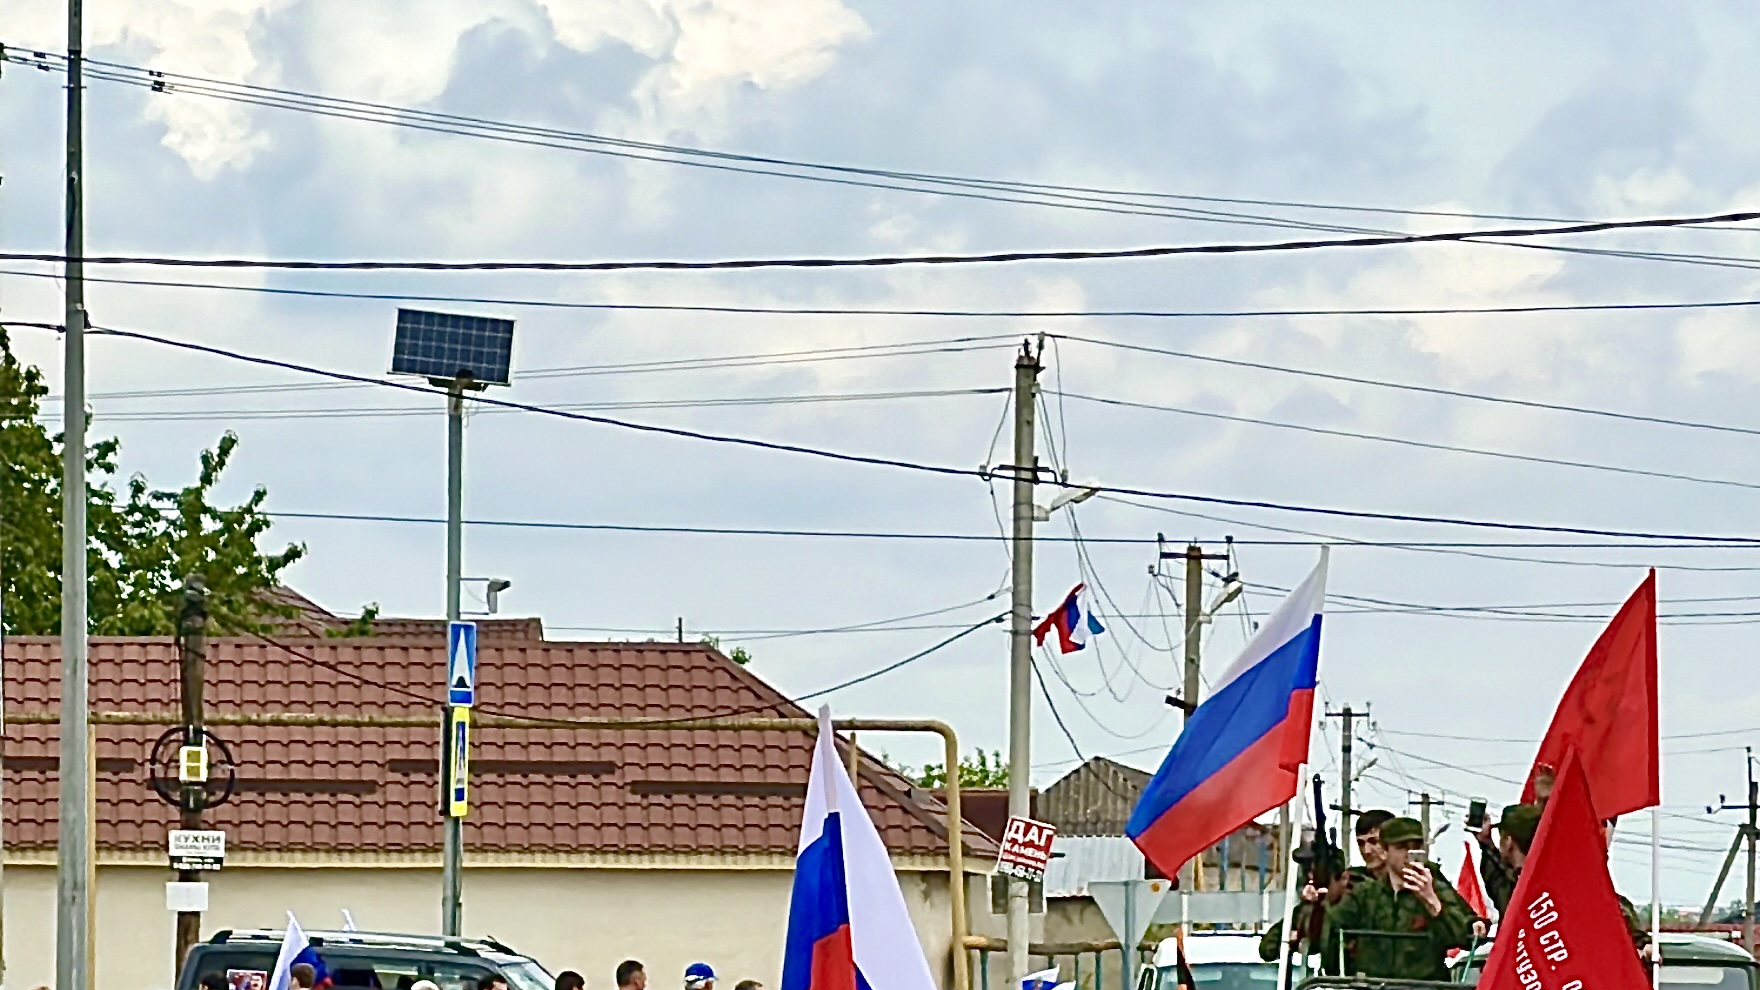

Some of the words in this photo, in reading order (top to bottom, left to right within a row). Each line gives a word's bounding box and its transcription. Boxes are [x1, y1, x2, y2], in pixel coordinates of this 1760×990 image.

[174, 834, 221, 844] КУХНИ
[1008, 820, 1054, 847] ДАГ
[1005, 841, 1047, 861] КАМЕНЬ
[1527, 891, 1559, 930] 150
[1539, 930, 1569, 971] СТР.
